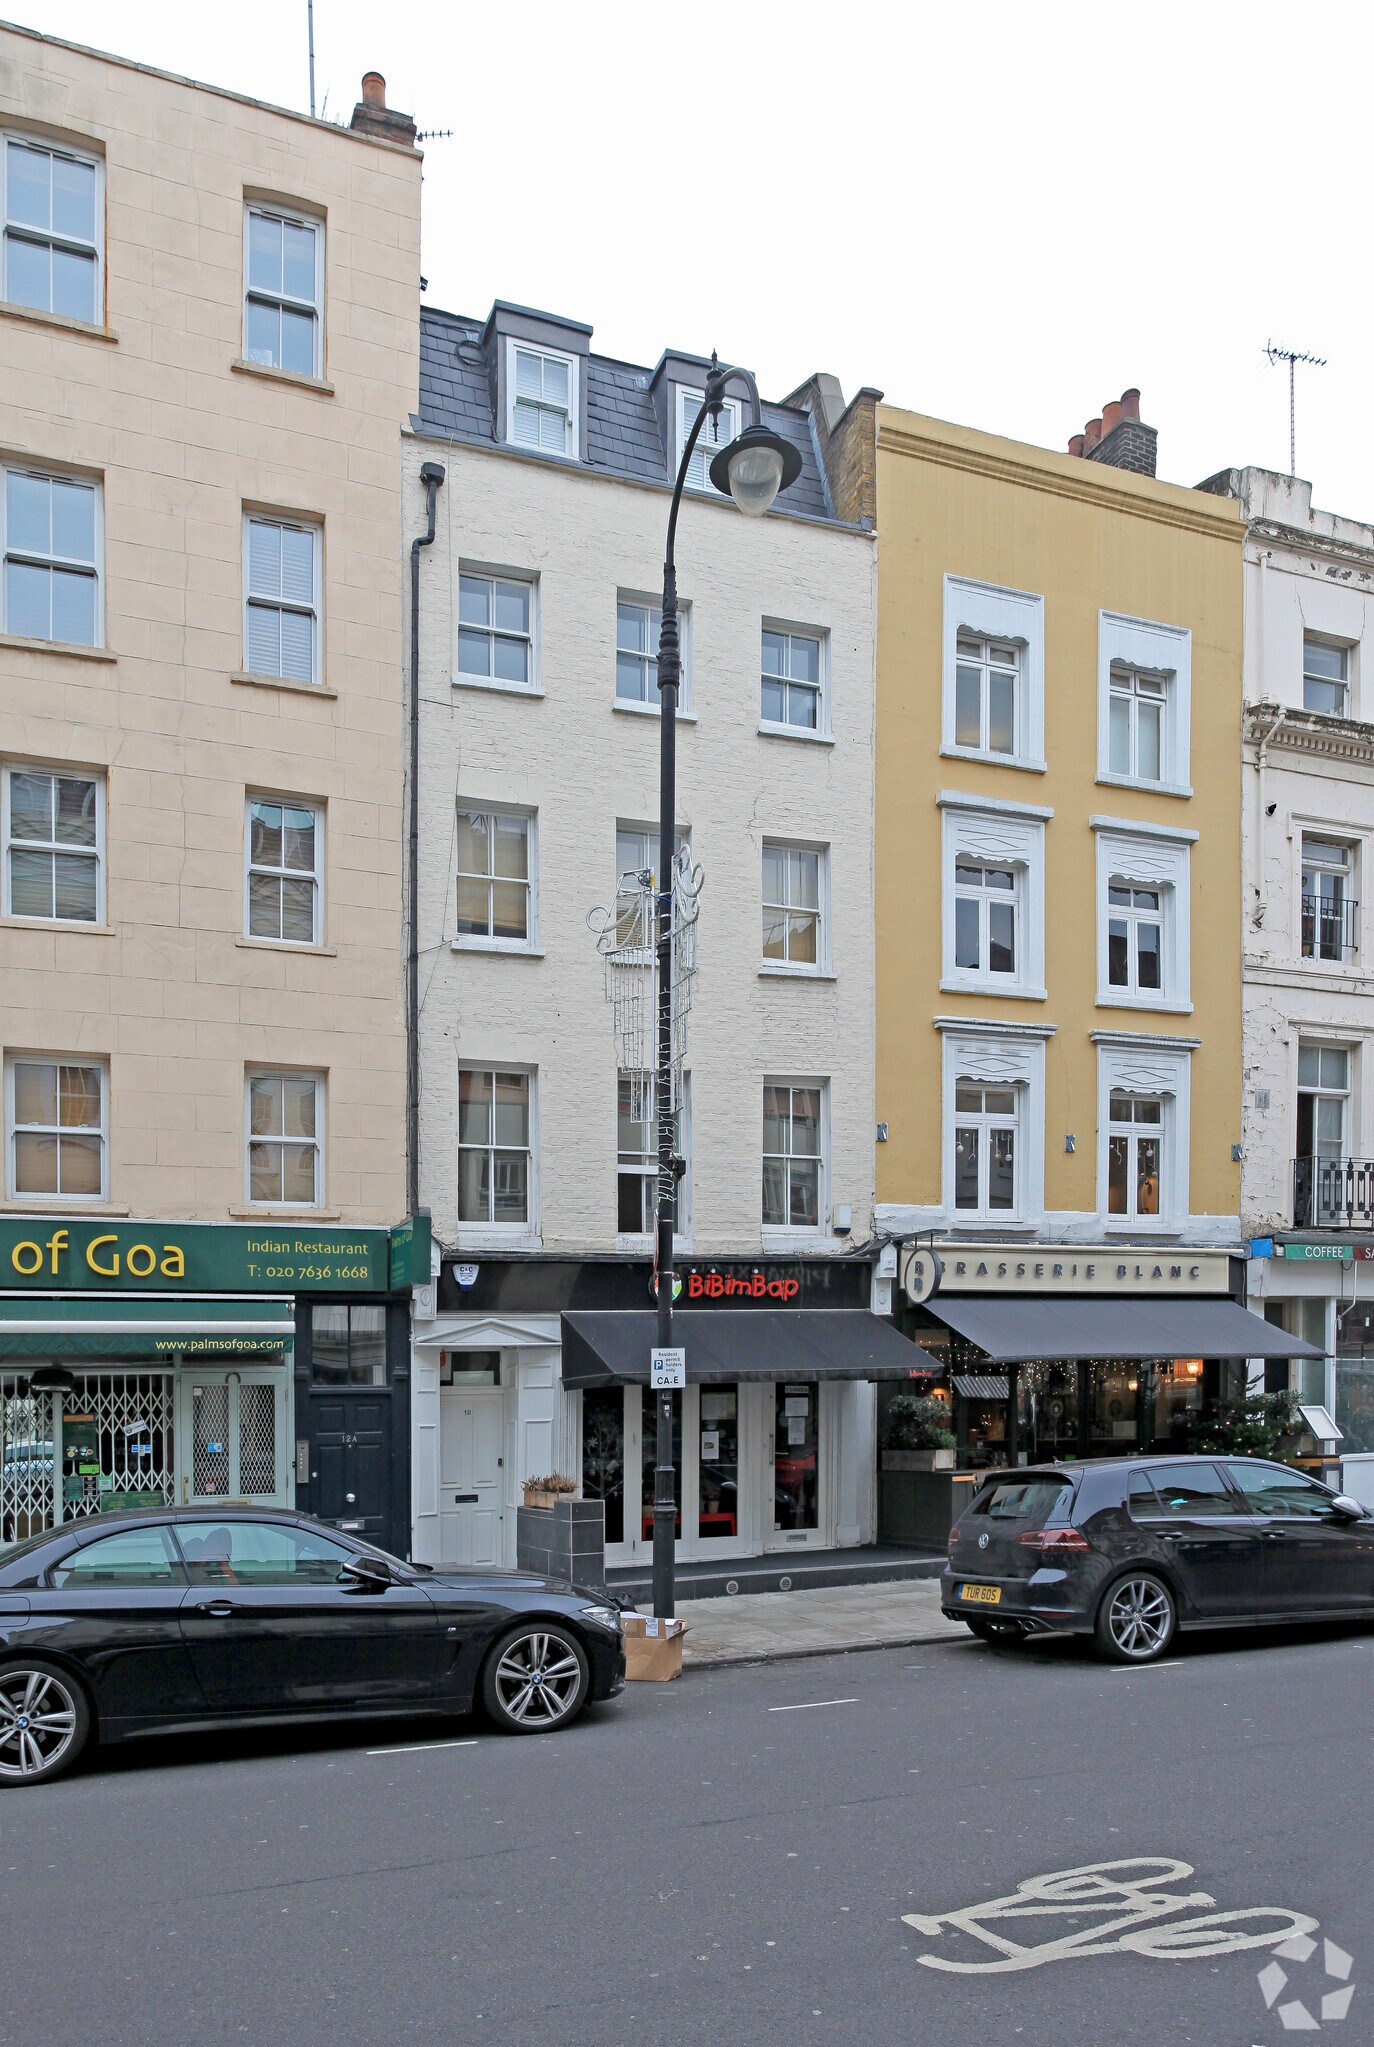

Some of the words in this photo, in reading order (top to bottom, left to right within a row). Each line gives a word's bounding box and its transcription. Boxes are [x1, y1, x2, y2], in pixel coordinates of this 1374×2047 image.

[11, 1229, 69, 1275] of
[86, 1234, 185, 1277] Goa
[247, 1240, 290, 1253] Indian
[295, 1241, 369, 1255] Restaurant
[1305, 1246, 1343, 1258] COFFEE
[247, 1264, 261, 1277] T:
[266, 1267, 294, 1277] 020
[298, 1265, 332, 1280] 7636
[336, 1266, 368, 1278] 1668
[1117, 1264, 1200, 1279] BLANC
[688, 1274, 799, 1301] BiBimBap
[155, 1338, 284, 1352] www.palmsofgoa.com
[655, 1360, 662, 1370] P
[342, 1435, 357, 1443] 12A
[967, 1586, 980, 1599] TUR
